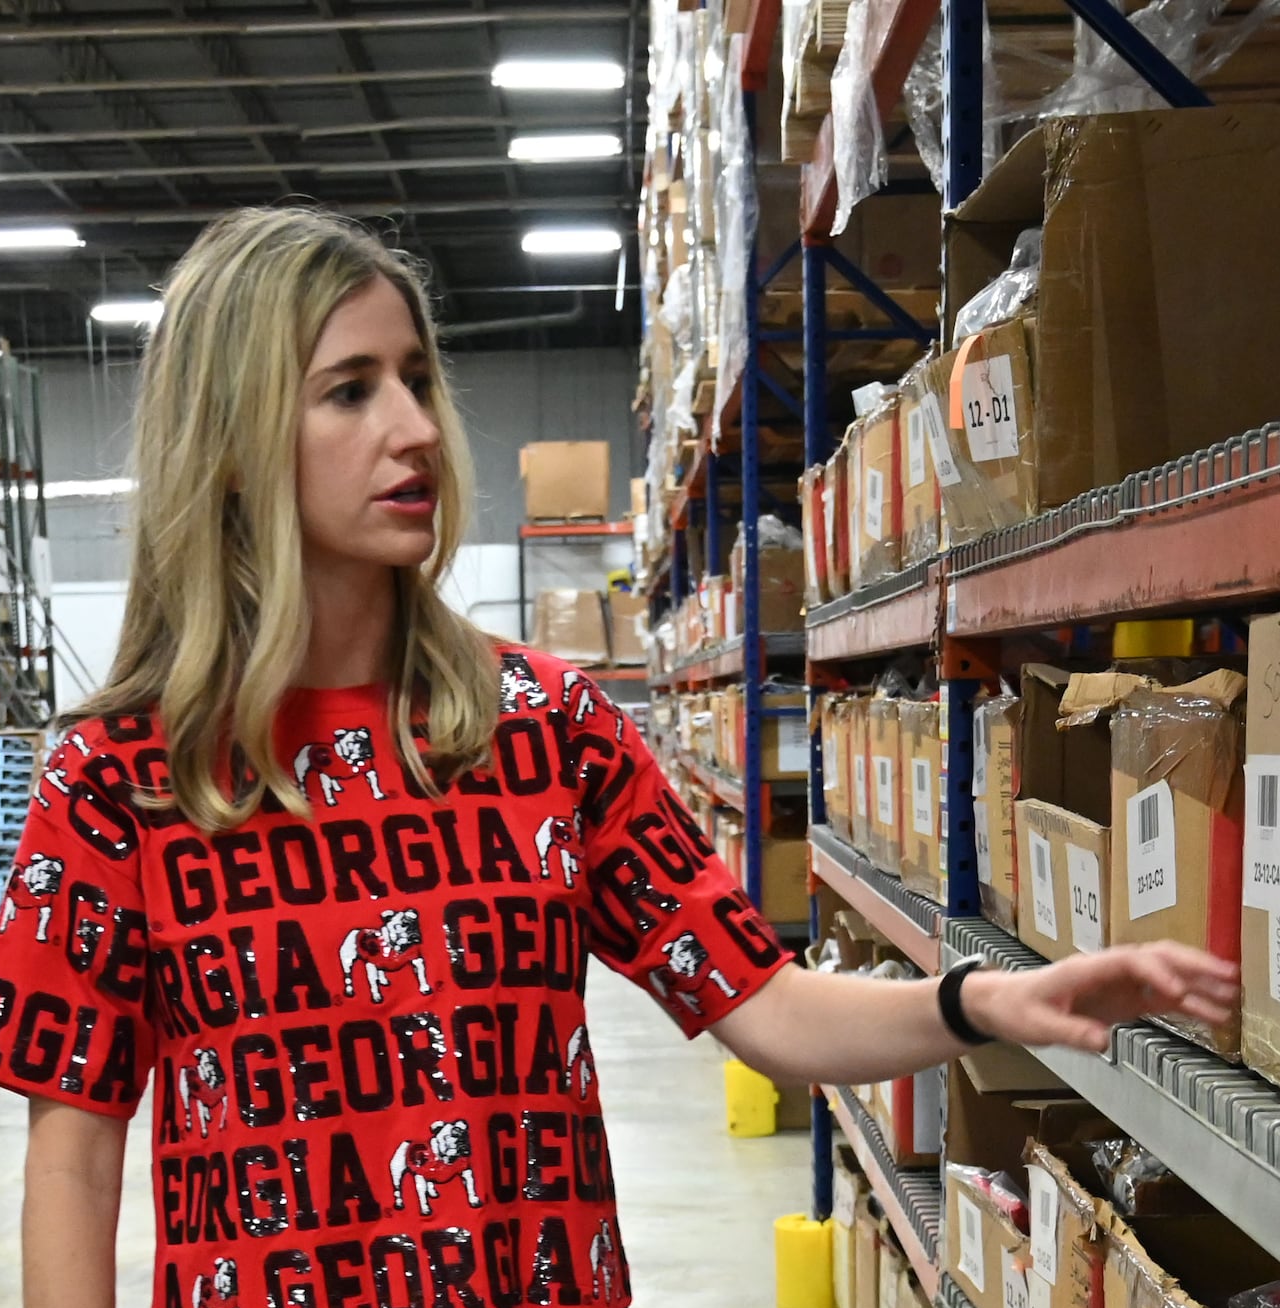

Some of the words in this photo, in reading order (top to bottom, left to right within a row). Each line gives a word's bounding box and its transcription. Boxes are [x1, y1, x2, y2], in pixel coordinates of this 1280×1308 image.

[162, 805, 533, 927] GEORGIA
[1136, 867, 1165, 895] 23-12-C3
[1252, 861, 1280, 886] 23-12-C4
[231, 1003, 572, 1129] GEORGIA
[160, 1132, 382, 1246] EORGIA
